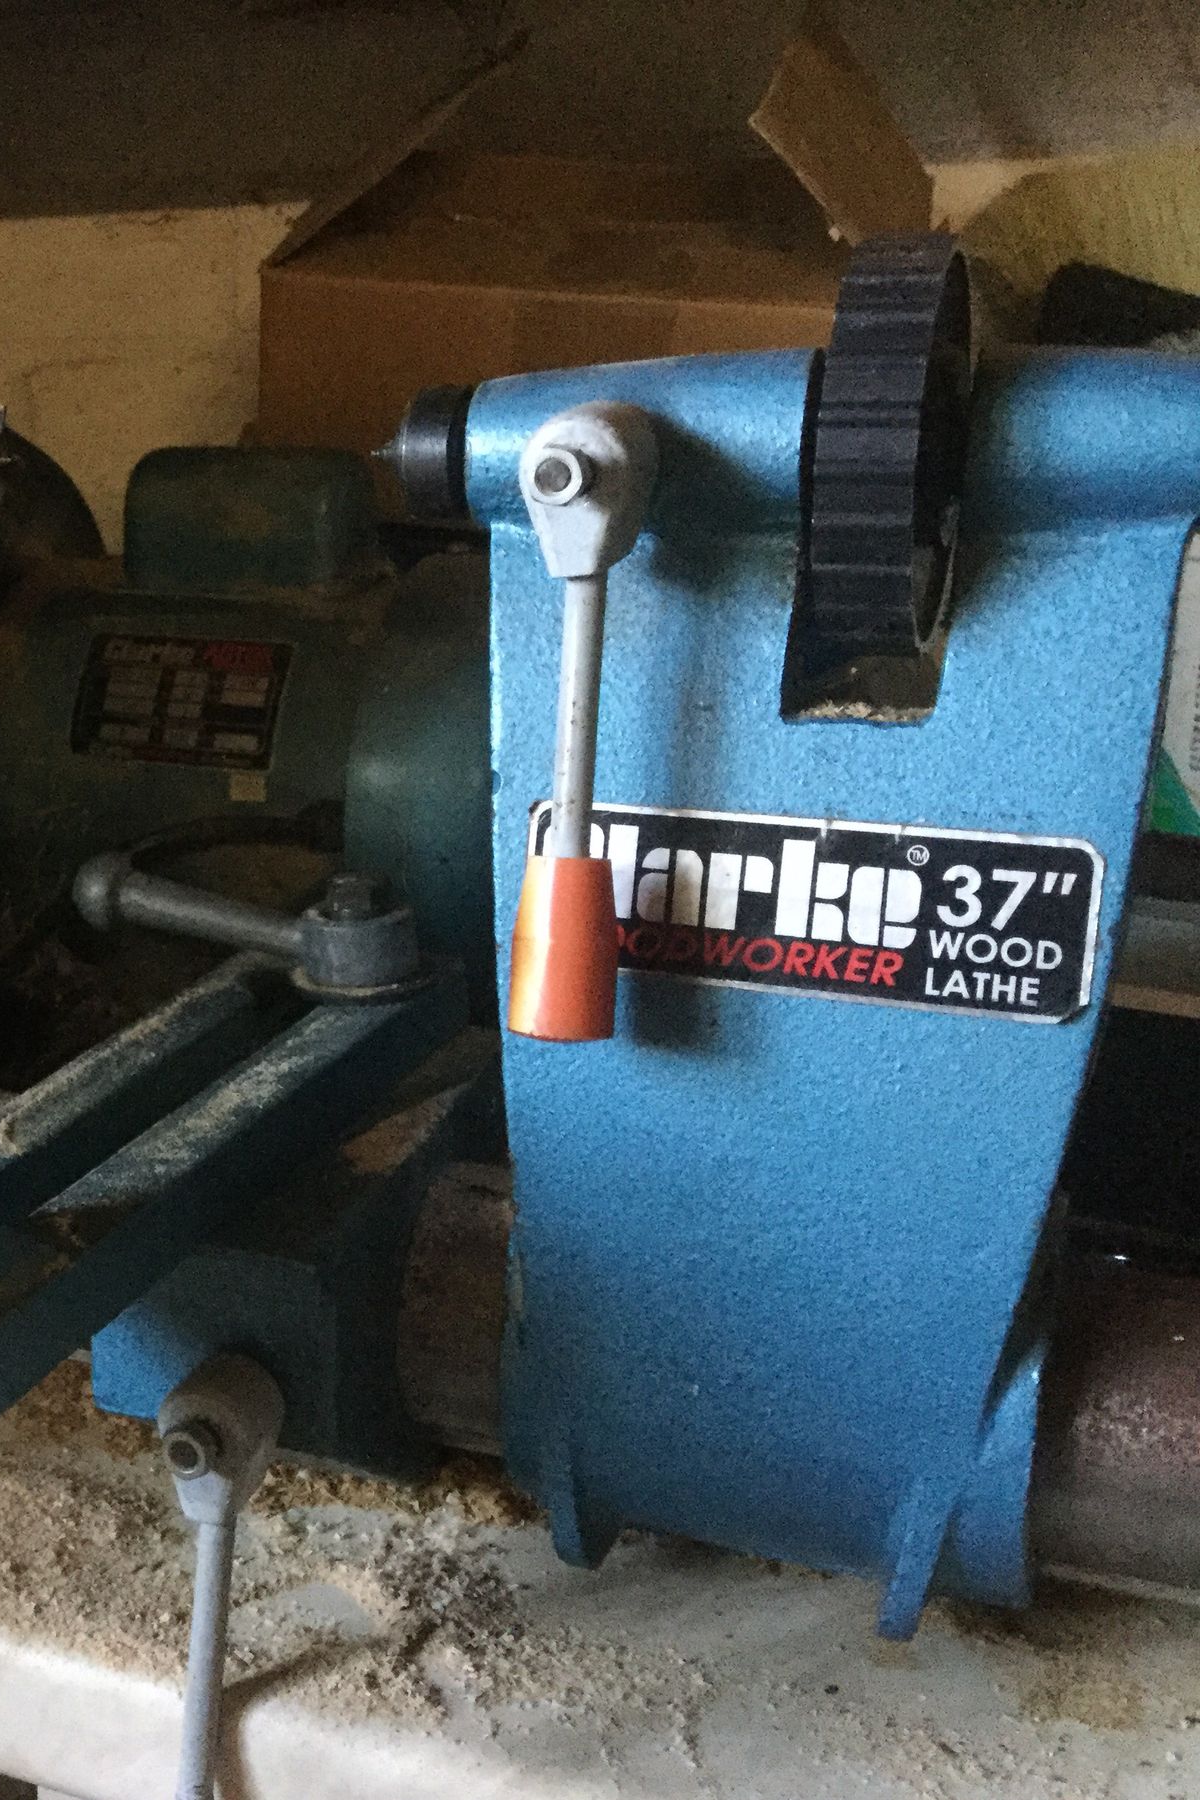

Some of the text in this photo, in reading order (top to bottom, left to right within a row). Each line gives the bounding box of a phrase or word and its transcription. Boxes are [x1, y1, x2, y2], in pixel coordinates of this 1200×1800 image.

[936, 864, 1077, 931] 37"
[929, 929, 1063, 970] WOOD
[925, 967, 1040, 1007] LATHE
